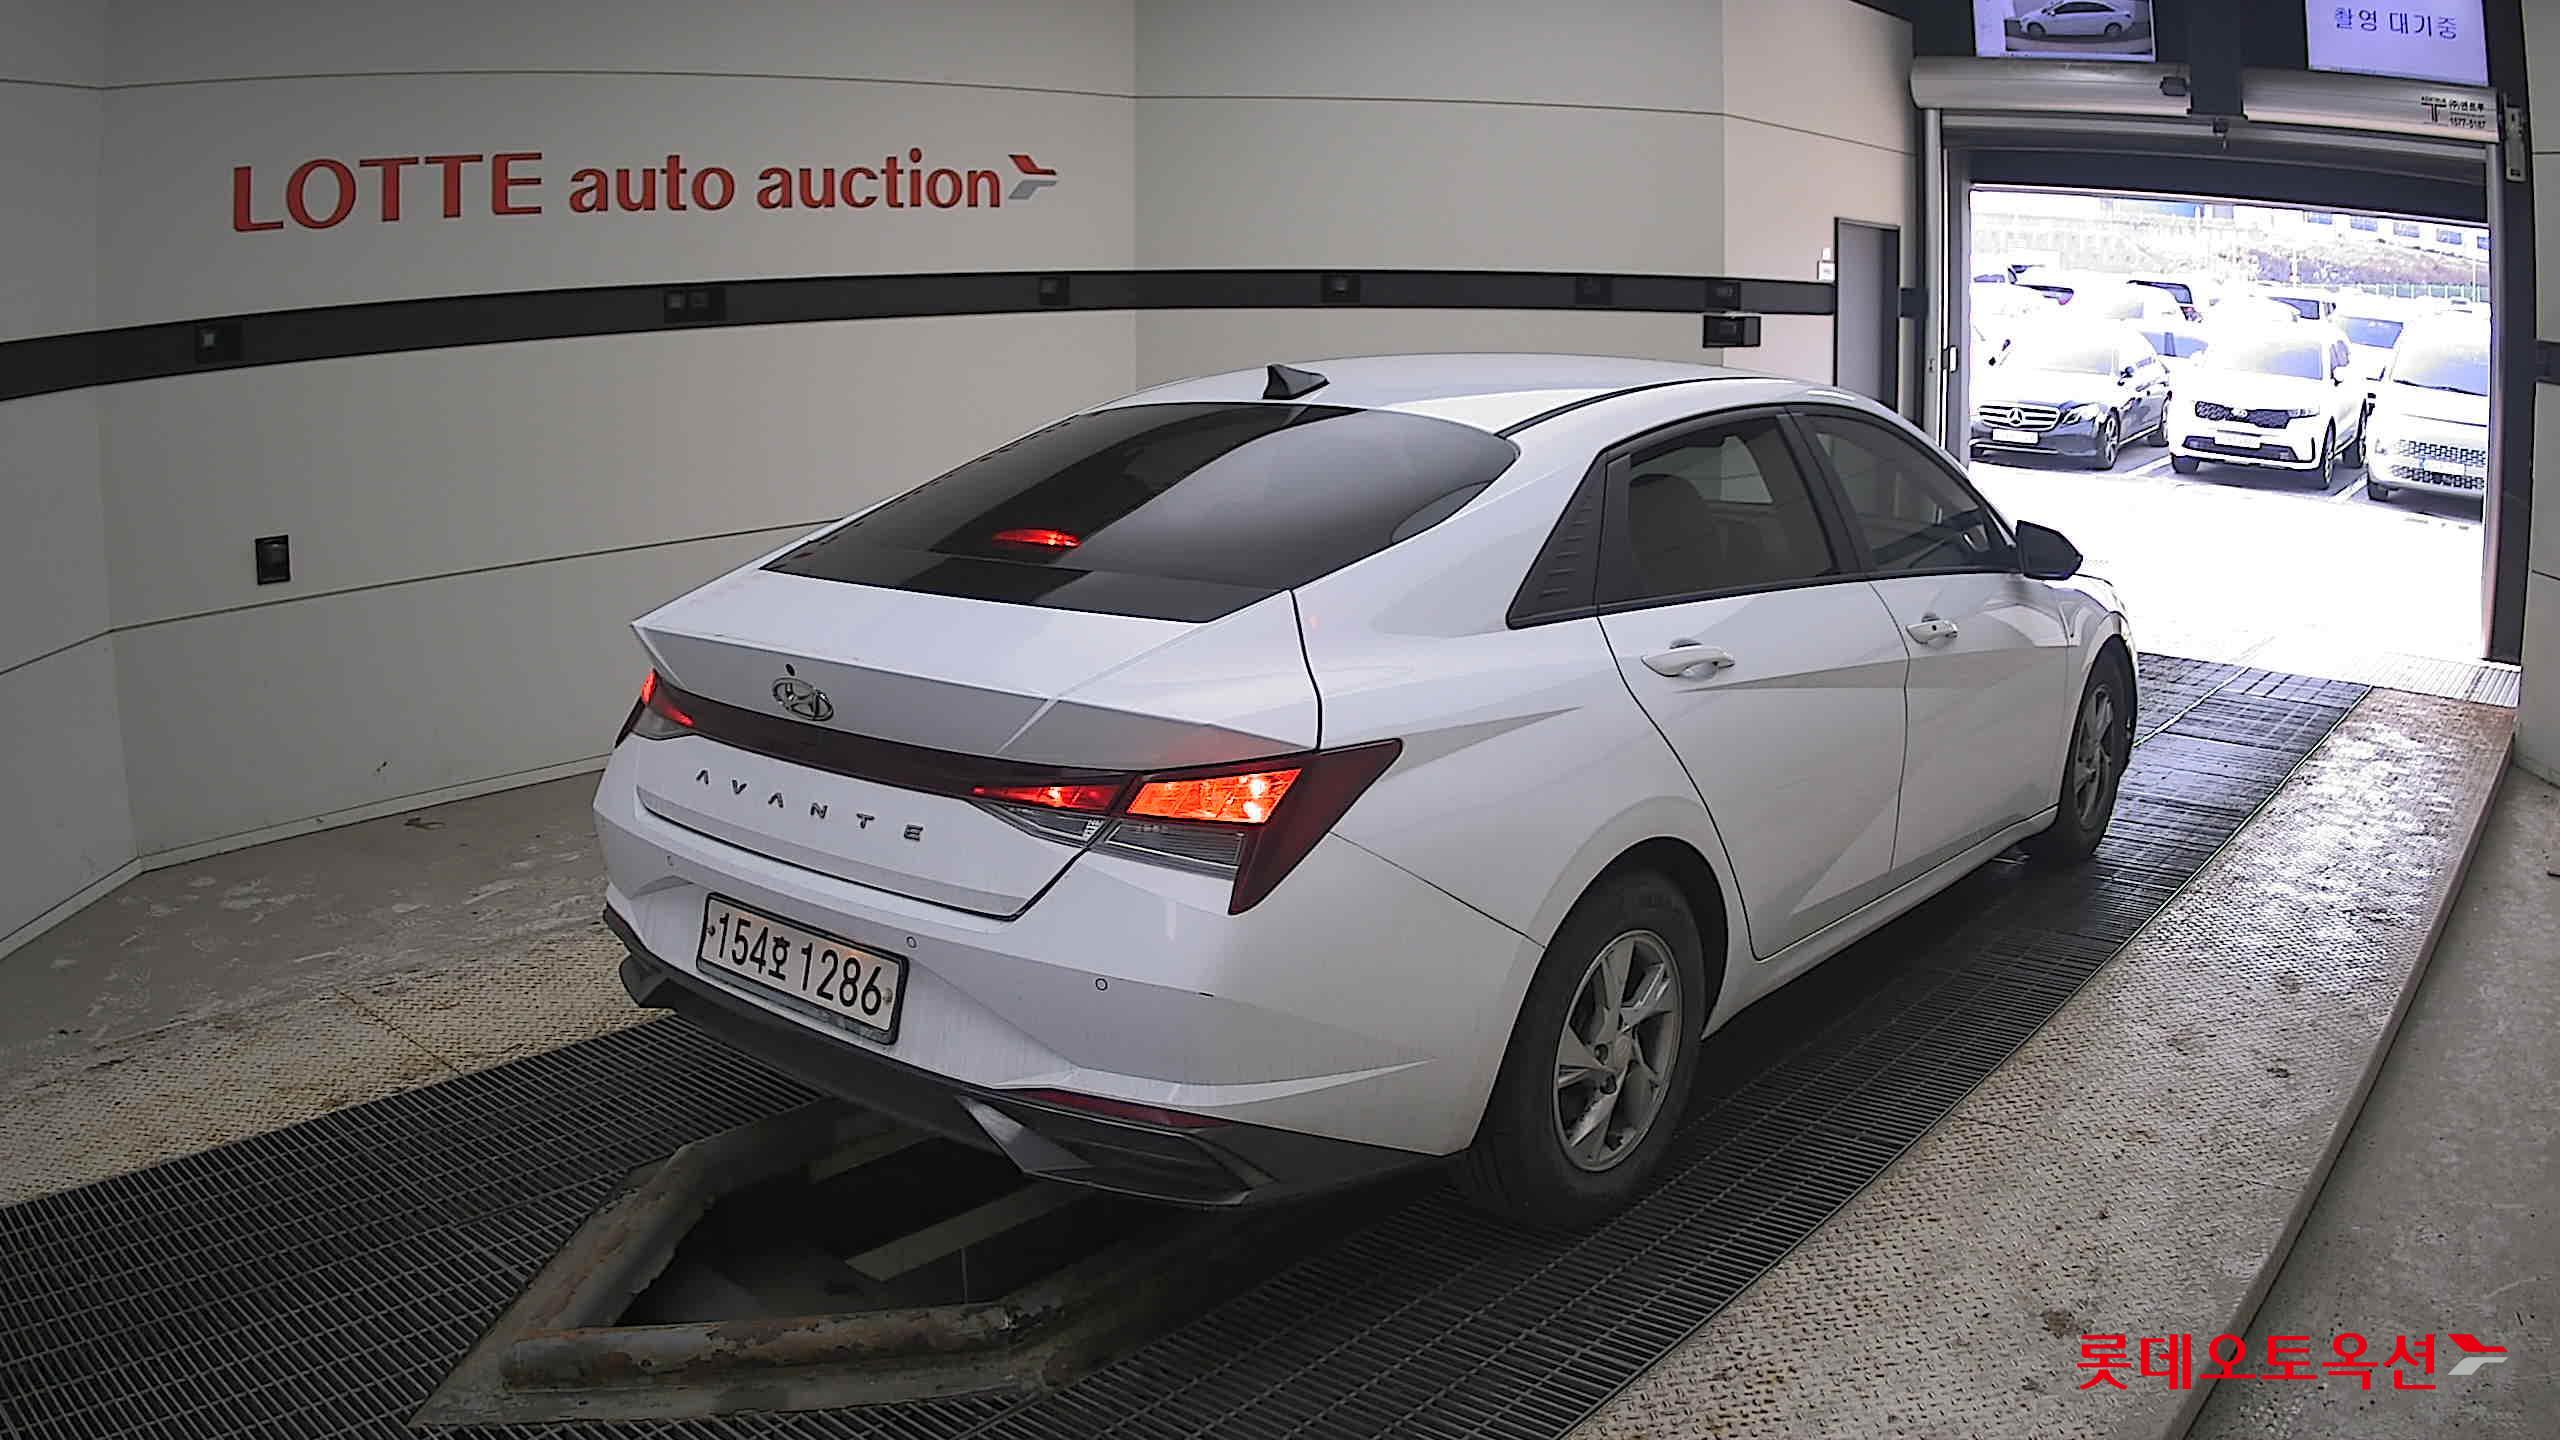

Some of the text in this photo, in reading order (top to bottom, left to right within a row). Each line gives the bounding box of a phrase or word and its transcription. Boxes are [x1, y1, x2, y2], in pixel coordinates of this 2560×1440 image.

[2334, 7, 2457, 40] 촬영 대기중
[233, 147, 1001, 233] LOTTE auto auction
[696, 769, 924, 842] AVANTE
[800, 942, 883, 1016] 1286
